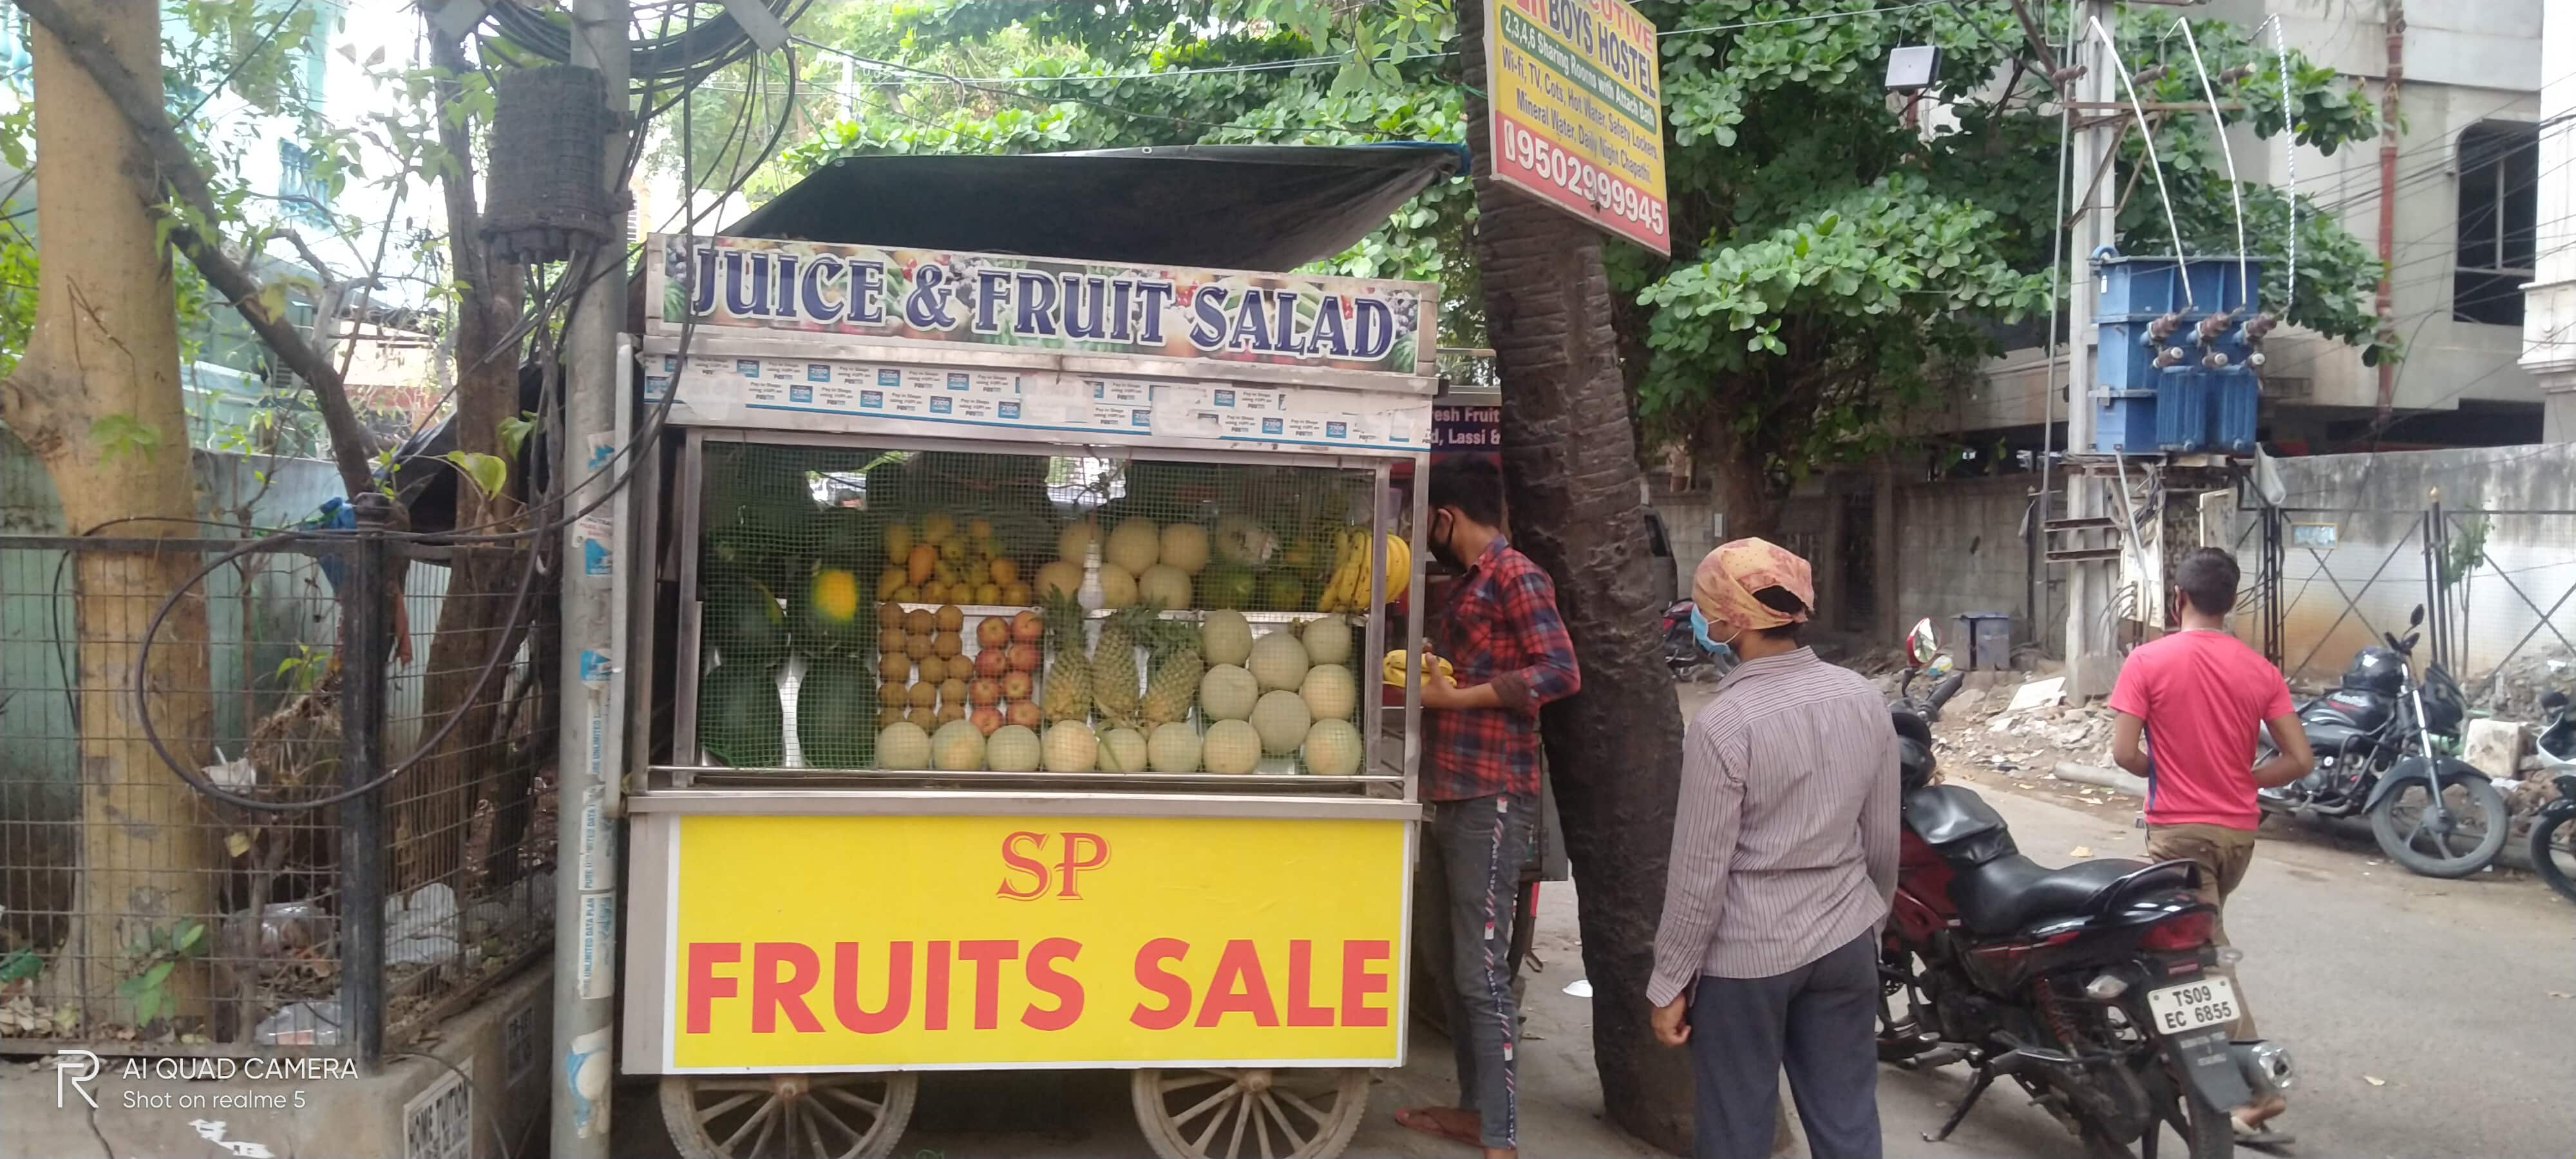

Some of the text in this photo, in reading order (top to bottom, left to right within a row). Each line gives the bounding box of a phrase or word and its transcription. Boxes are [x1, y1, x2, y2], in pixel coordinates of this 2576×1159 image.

[1504, 10, 1536, 50] 2,3,4,6
[1537, 33, 1569, 75] Sharing
[1571, 54, 1597, 89] Rooms
[1598, 77, 1615, 100] with
[1616, 85, 1639, 117] Attach
[1549, 0, 1656, 99] BOYS HOSTEL
[1517, 88, 1549, 126] Mineral
[1578, 124, 1598, 160] Daily
[1567, 87, 1582, 113] Hot
[1609, 112, 1631, 147] Safety
[1517, 128, 1663, 236] 9502999945
[692, 247, 1394, 358] JUICE & FRUIT SALAD
[1432, 407, 1460, 422] esh
[1448, 429, 1486, 444] Lassi
[996, 830, 1111, 901] SP
[686, 937, 1084, 1034] FRUITS
[1129, 937, 1390, 1030] SALE
[2164, 1001, 2232, 1030] EC 6855
[2172, 985, 2211, 1007] TS09
